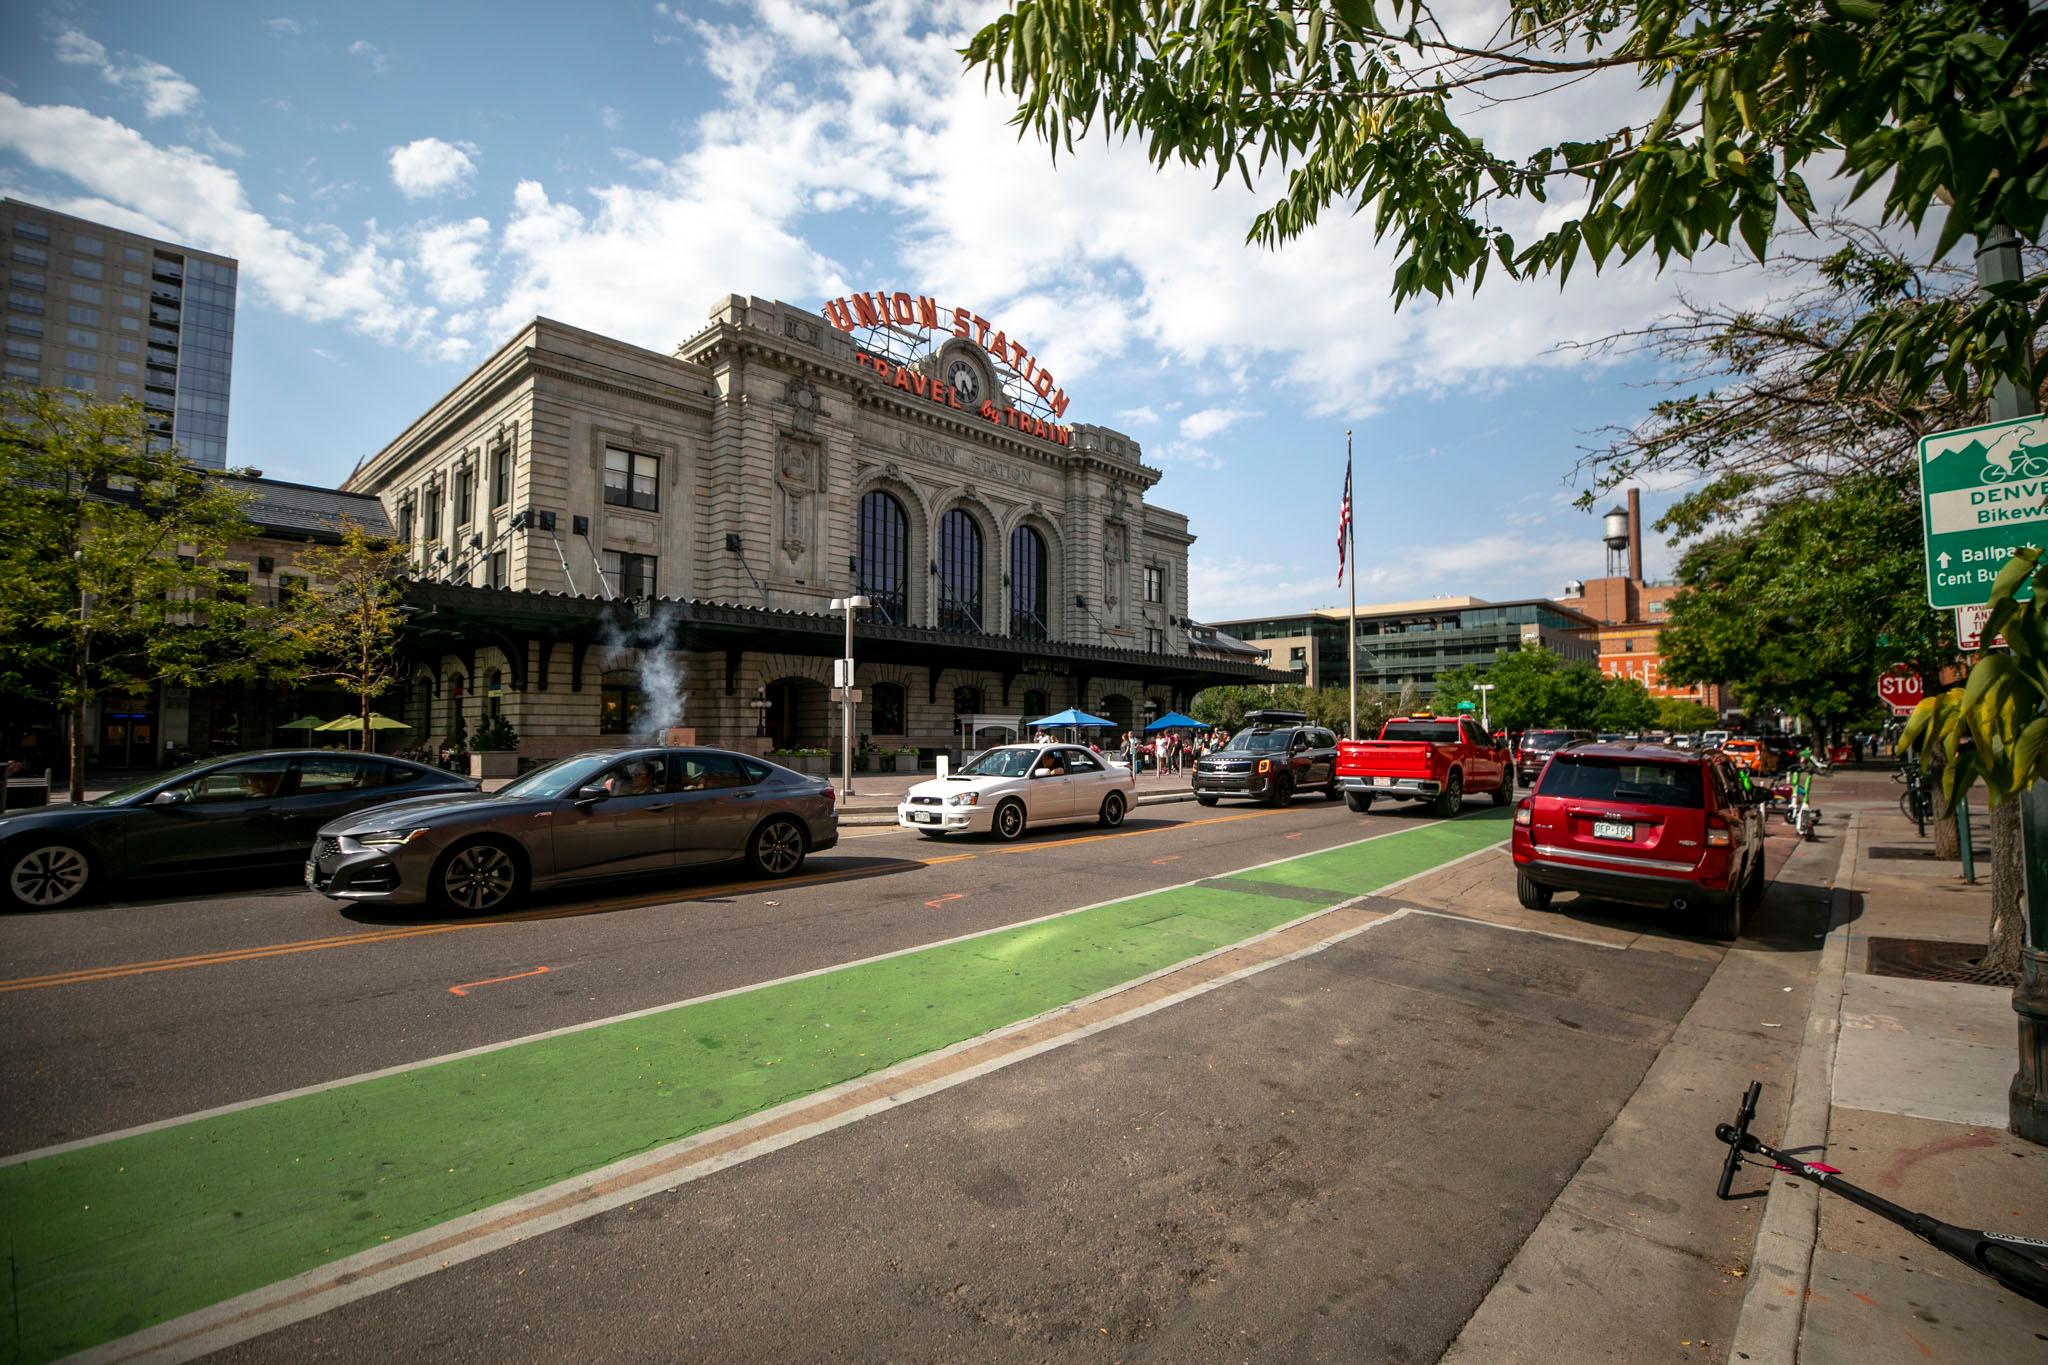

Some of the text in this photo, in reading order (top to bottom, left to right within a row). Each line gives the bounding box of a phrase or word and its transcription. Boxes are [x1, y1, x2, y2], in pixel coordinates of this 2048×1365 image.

[825, 290, 1070, 419] UNION STATION
[856, 352, 1070, 446] TRAVEL by TRAIN
[899, 433, 1032, 484] UNION STATION
[1961, 542, 2036, 562] Ballpak
[1937, 568, 2001, 586] Cent Bu
[1882, 676, 1923, 694] STO
[1986, 1231, 2048, 1245] 600-60
